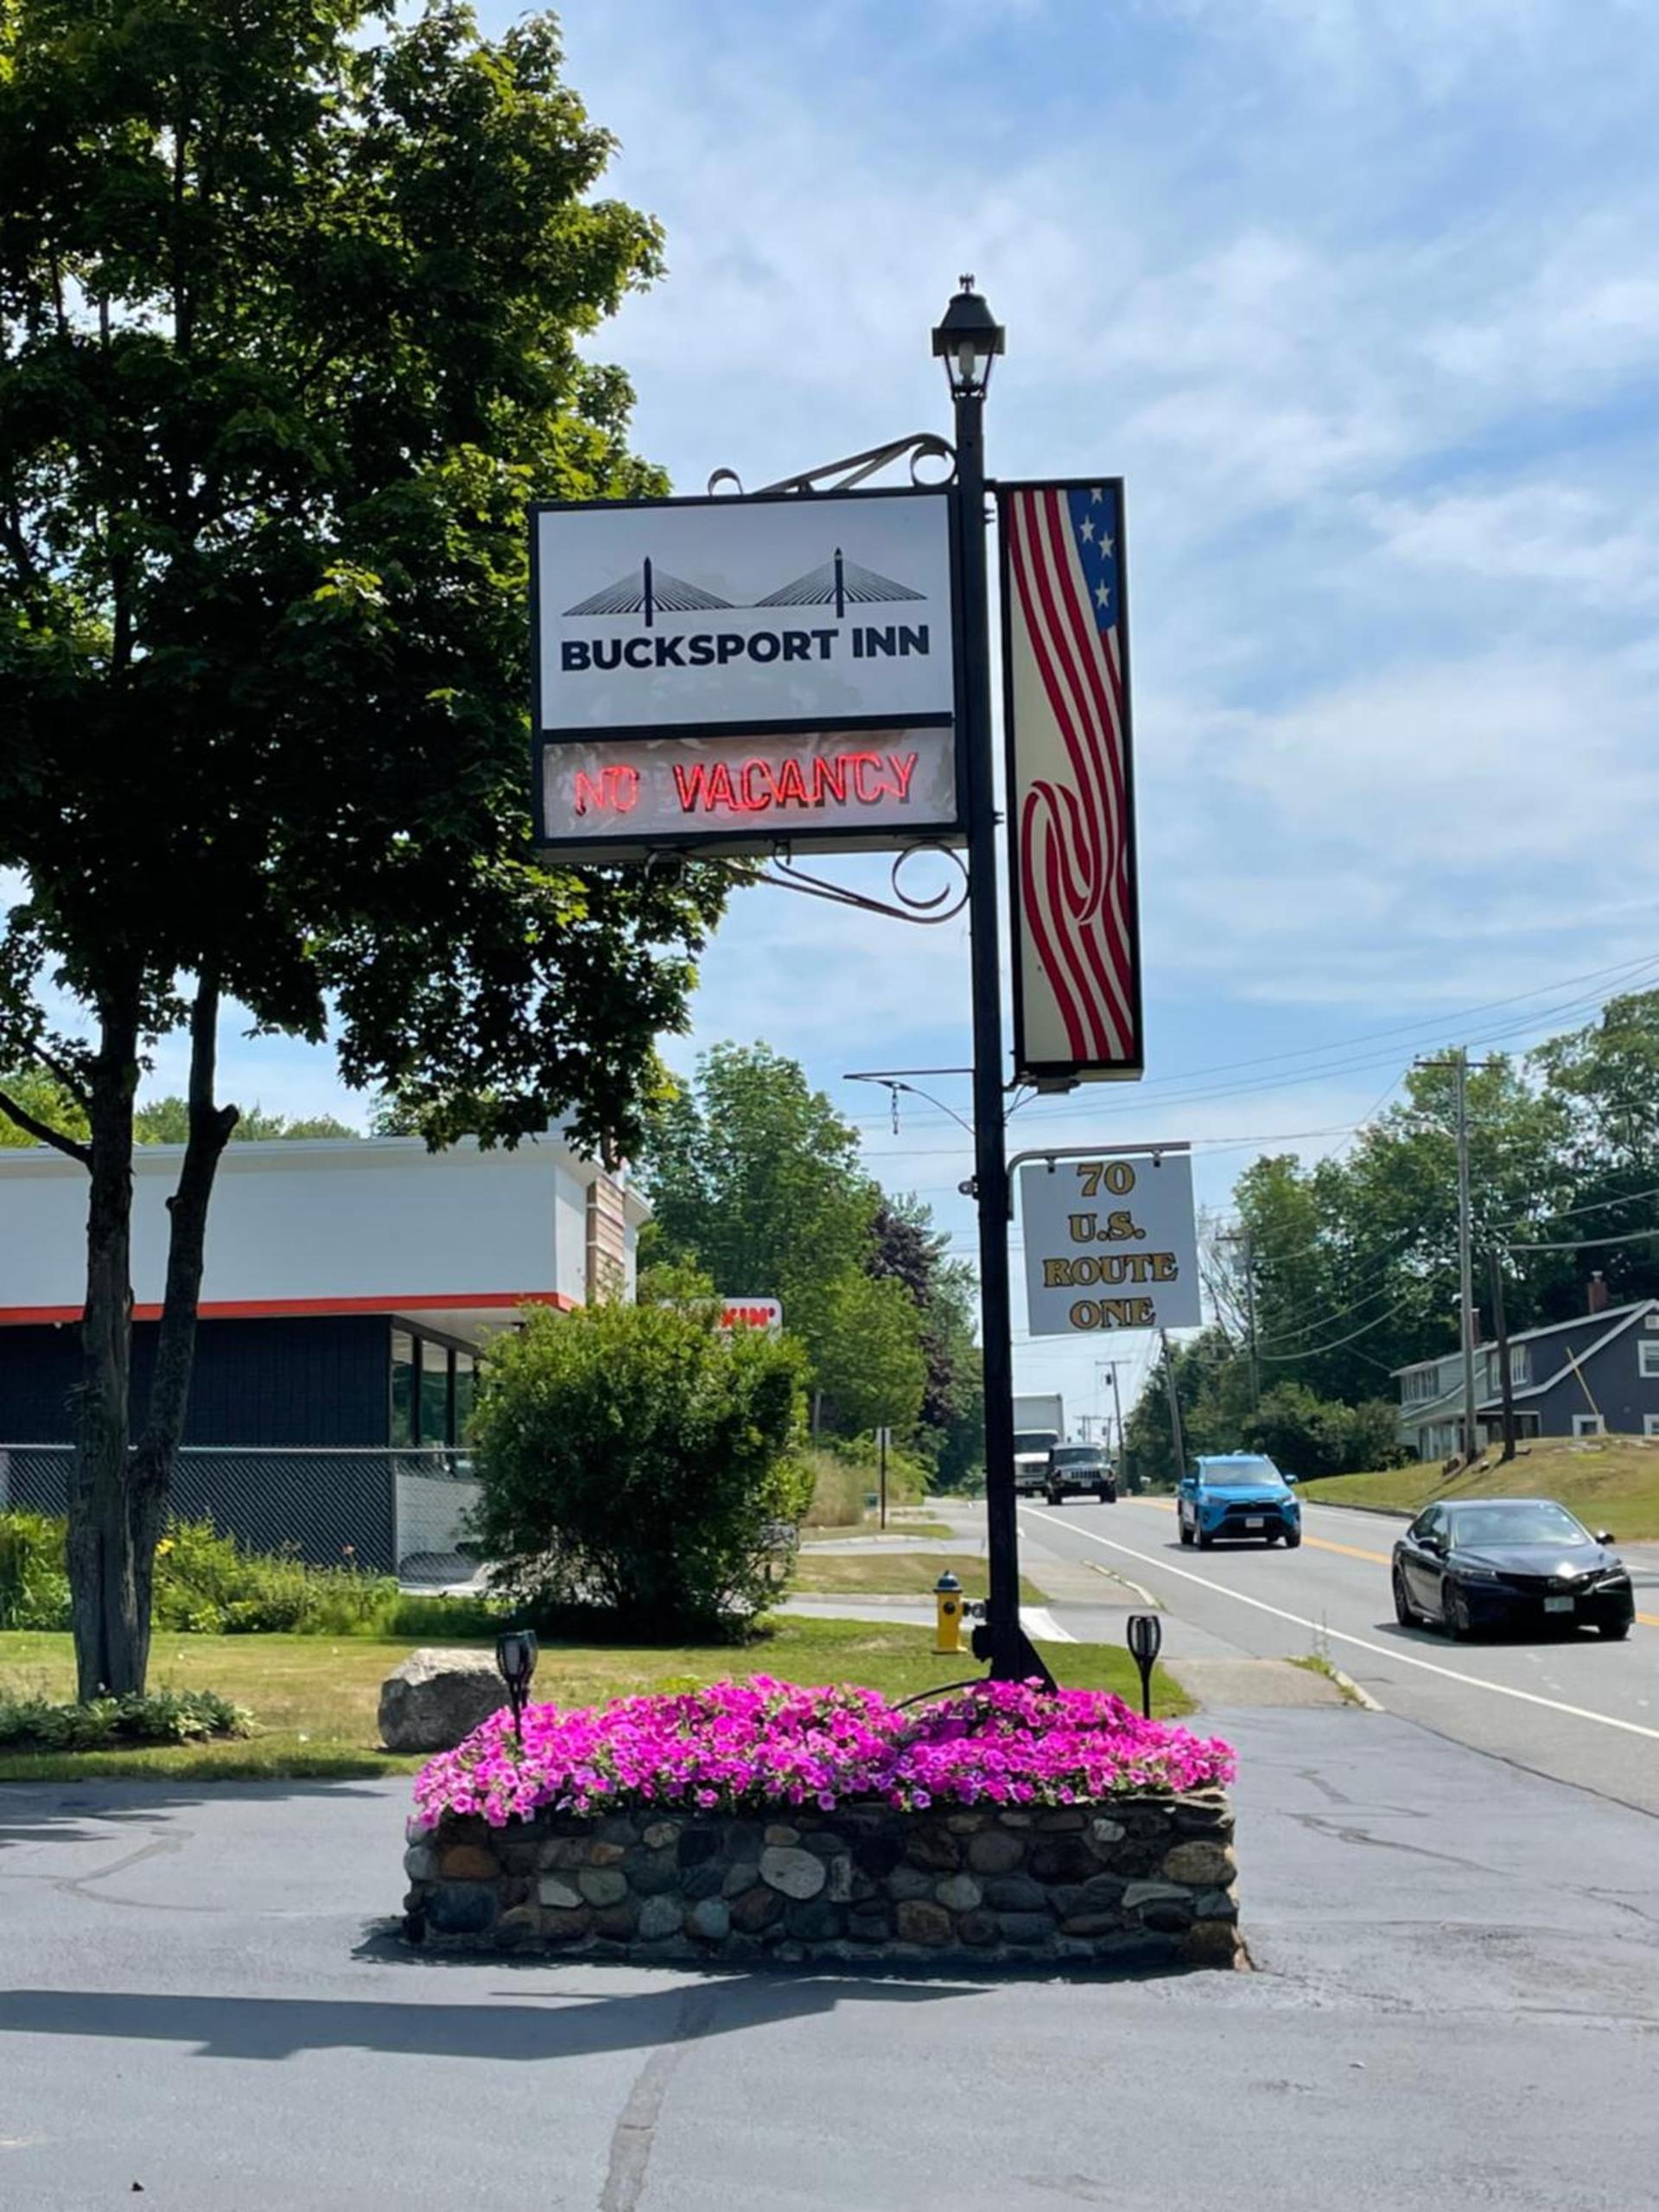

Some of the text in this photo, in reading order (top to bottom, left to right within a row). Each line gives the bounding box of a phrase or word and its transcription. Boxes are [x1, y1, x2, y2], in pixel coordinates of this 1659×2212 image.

[560, 624, 931, 672] BUCKSPORT INN
[575, 752, 918, 815] NO VACANCY
[1077, 1161, 1136, 1198] 70
[1068, 1211, 1147, 1243] U.S.
[1042, 1252, 1179, 1288] ROUTE
[1069, 1296, 1157, 1331] ONE
